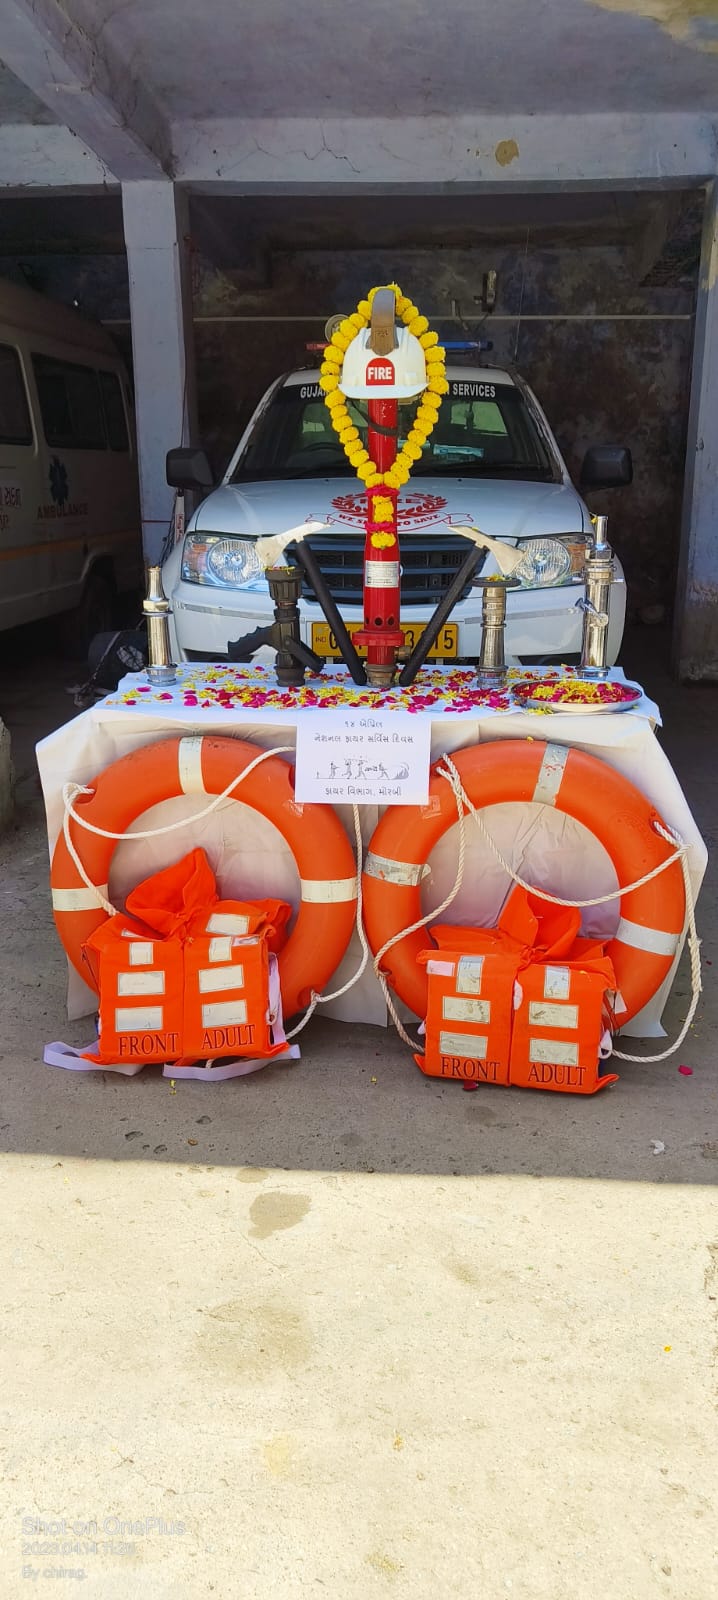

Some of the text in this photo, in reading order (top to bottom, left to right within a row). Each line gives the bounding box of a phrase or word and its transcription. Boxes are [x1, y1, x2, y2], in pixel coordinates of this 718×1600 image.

[368, 366, 393, 380] FIRE
[300, 385, 328, 399] GUJA
[452, 383, 496, 398] SERVICES
[37, 503, 89, 520] AMBULANCE
[338, 514, 353, 522] WE
[413, 514, 441, 525] SAVE
[344, 720, 355, 728] ૧૪
[314, 732, 341, 742] નેશનલ
[367, 732, 389, 743] સર્વિસ
[392, 732, 414, 743] દિવસ
[325, 787, 344, 796] ફાયર
[378, 786, 402, 796] મોરબી
[118, 1032, 179, 1056] FRONT
[201, 1024, 255, 1050] ADULT
[440, 1056, 501, 1081] FRONT
[527, 1062, 587, 1086] ADULT
